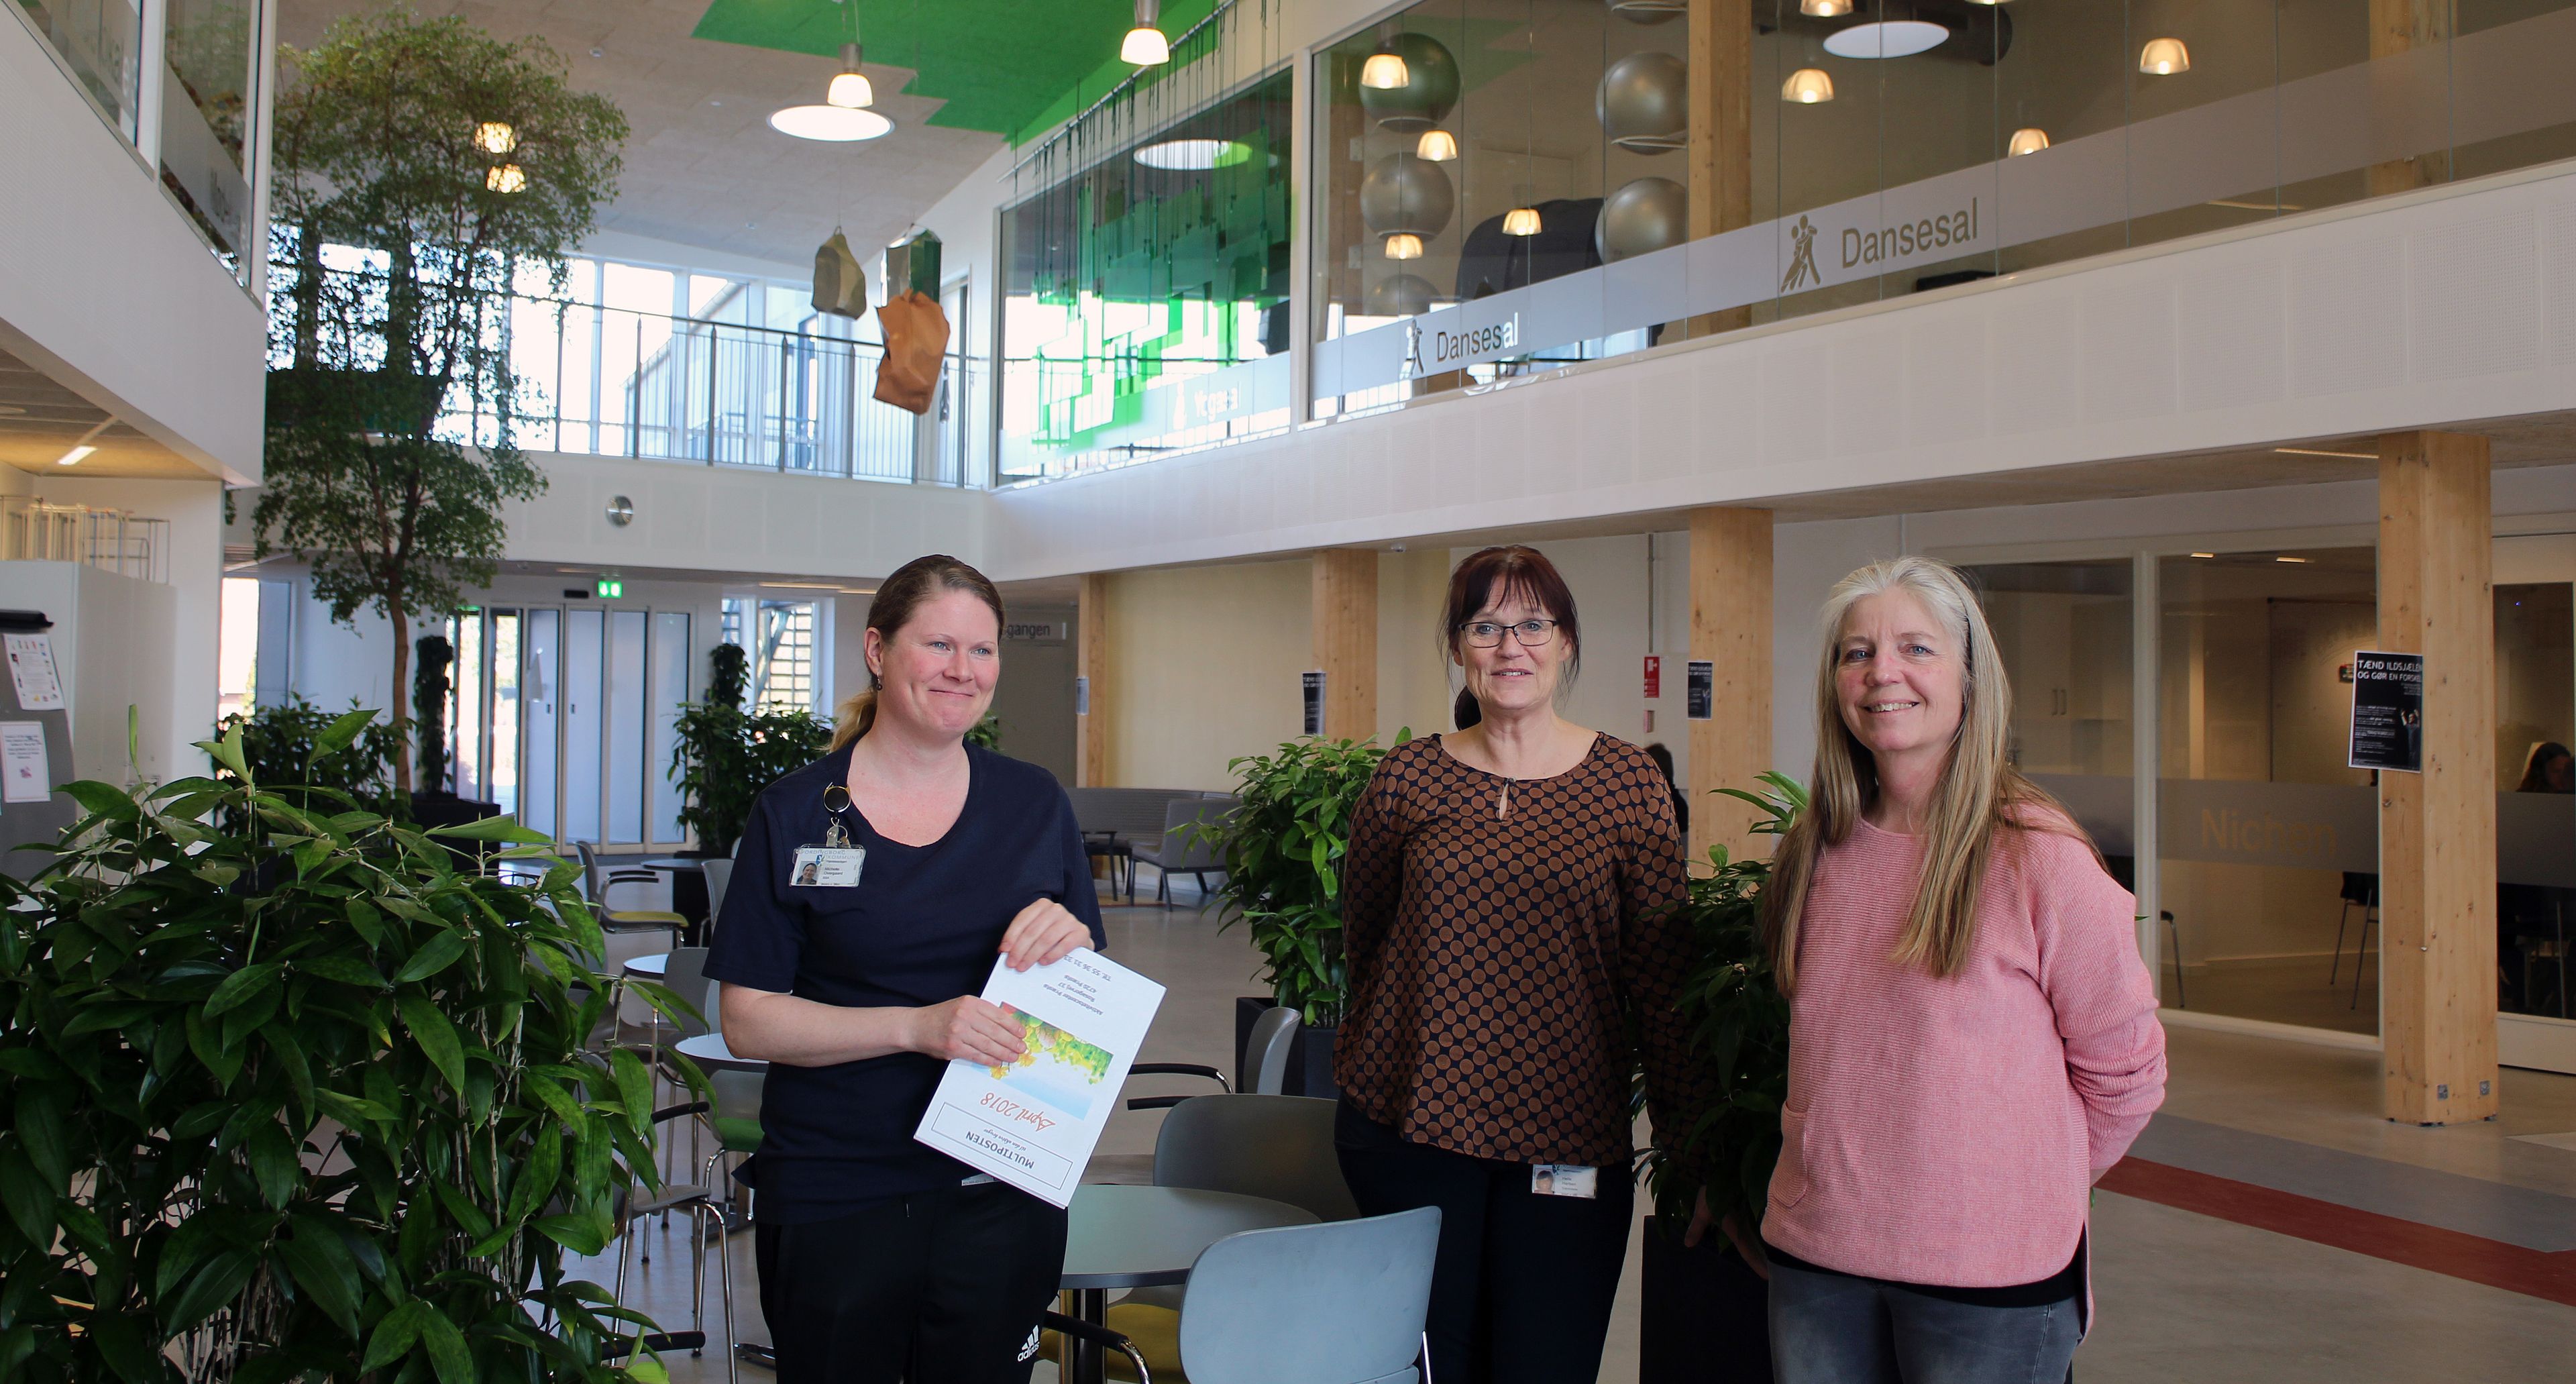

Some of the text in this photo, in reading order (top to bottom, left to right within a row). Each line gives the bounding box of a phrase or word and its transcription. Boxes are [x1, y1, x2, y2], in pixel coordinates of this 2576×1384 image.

[1842, 197, 1977, 268] Dansesal
[1437, 312, 1518, 362] Dansesal
[2357, 671, 2369, 680] OG
[2371, 672, 2387, 680] GØR
[2389, 673, 2398, 681] EN
[2358, 660, 2385, 670] TÆND
[2202, 808, 2337, 855] Nichen
[980, 1092, 1056, 1132] April 2018
[965, 1131, 1034, 1169] MULTIPOSTEN
[1017, 1342, 1040, 1362] adidas
